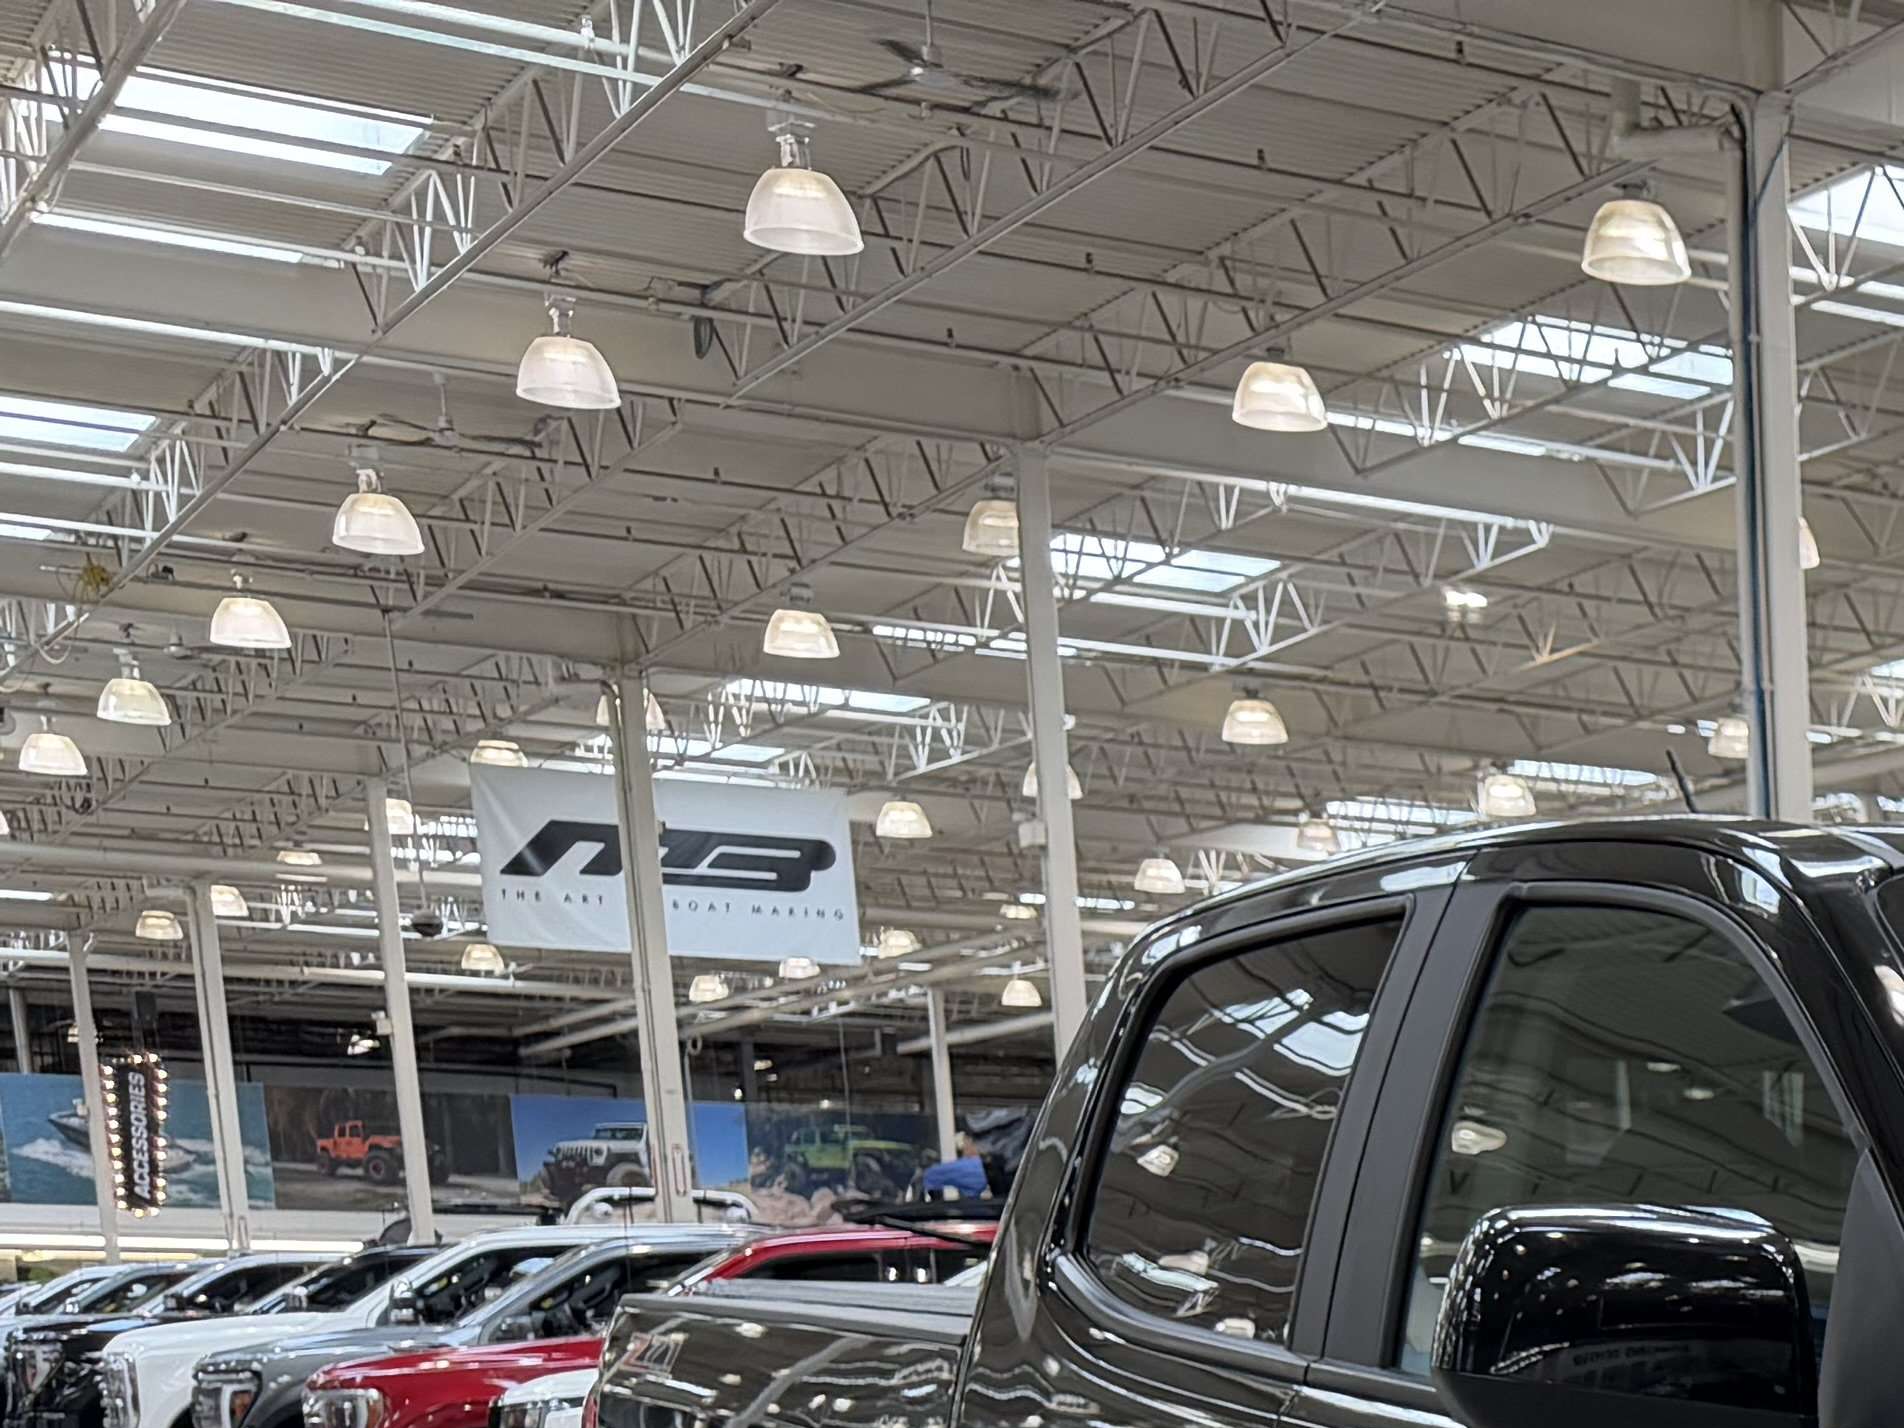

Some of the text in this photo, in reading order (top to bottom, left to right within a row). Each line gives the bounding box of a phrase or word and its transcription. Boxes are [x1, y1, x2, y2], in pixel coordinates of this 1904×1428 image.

[500, 888, 845, 922] THE ART BOAT MAKING
[128, 1071, 150, 1199] ACCESSORIES
